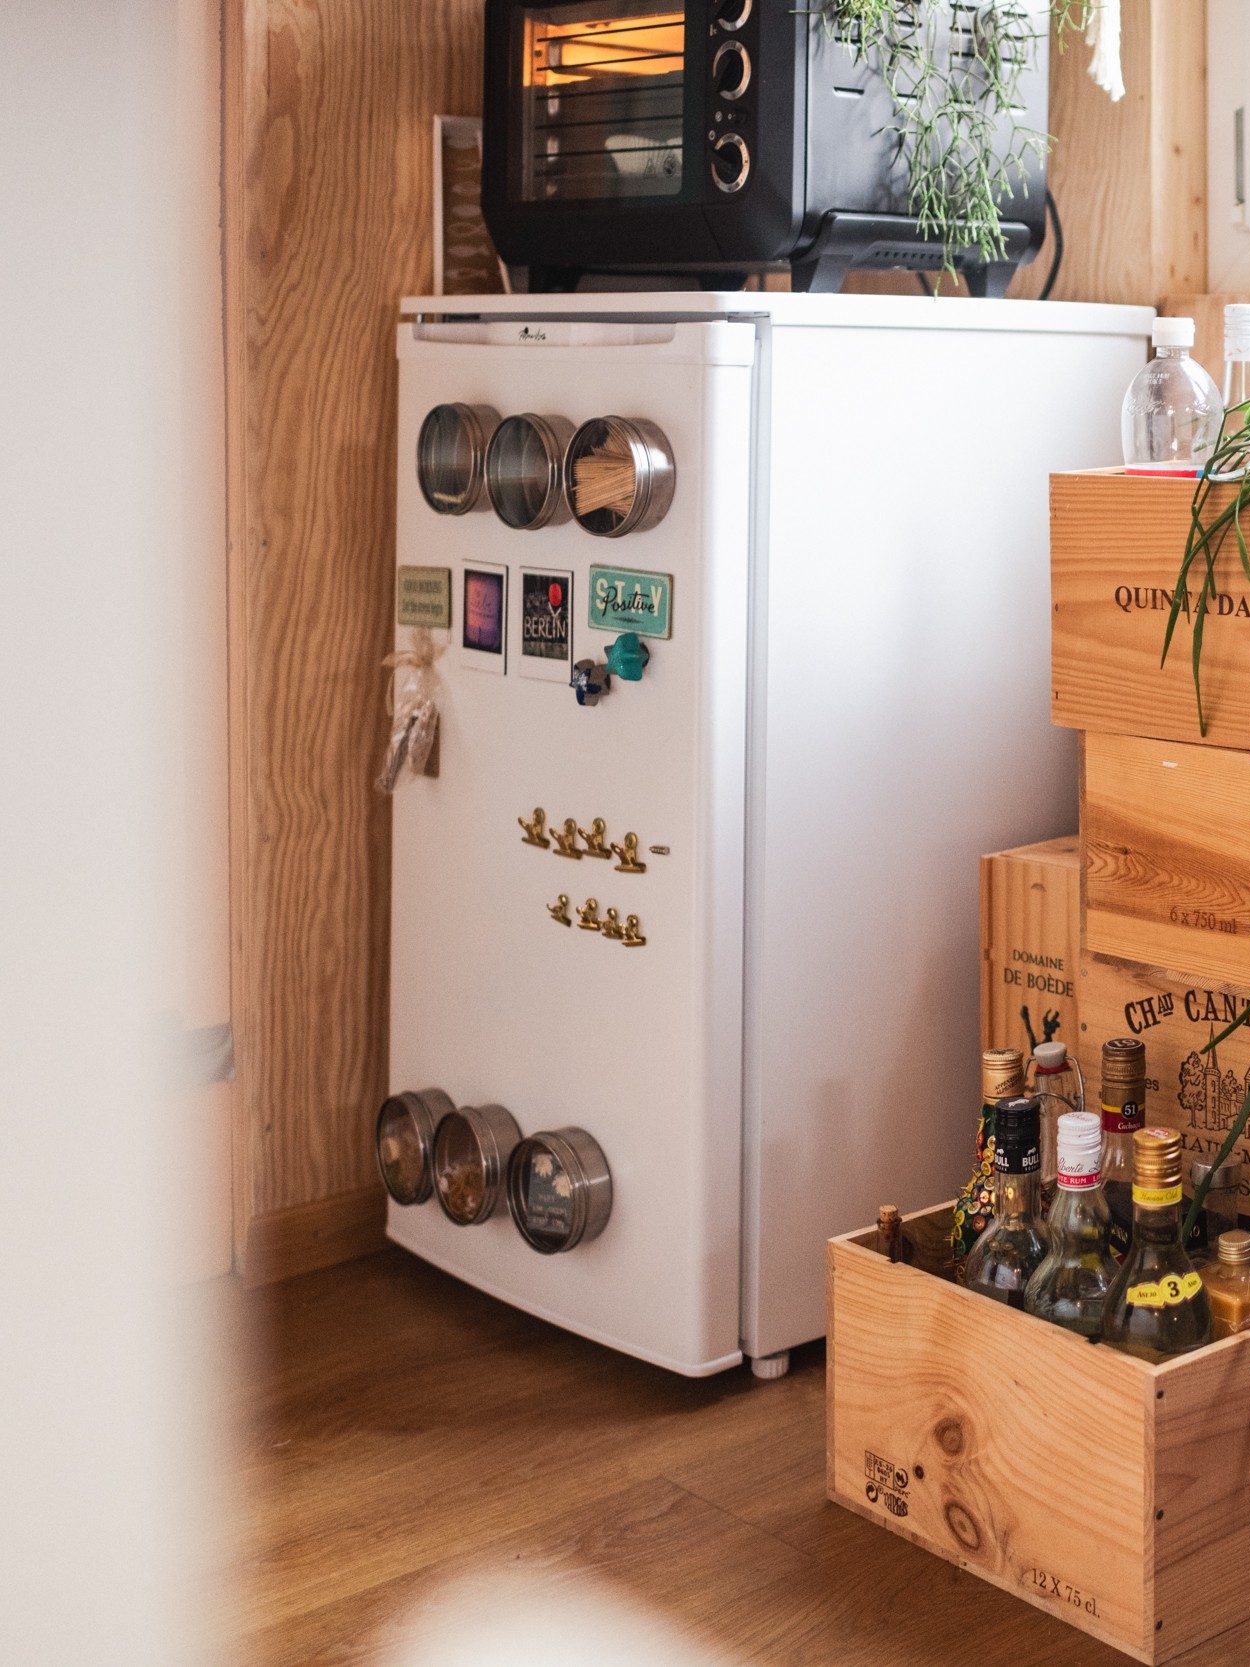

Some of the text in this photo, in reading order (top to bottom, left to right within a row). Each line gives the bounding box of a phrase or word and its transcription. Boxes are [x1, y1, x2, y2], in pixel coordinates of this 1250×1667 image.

[595, 577, 663, 617] STAY
[601, 586, 655, 617] Positive
[524, 616, 566, 639] BERLIN
[1170, 905, 1178, 922] 6
[1193, 908, 1216, 930] 750
[1219, 918, 1237, 935] ml
[1013, 949, 1064, 971] DOMAINE
[1003, 967, 1074, 998] DE BOÈDE
[1124, 1103, 1136, 1117] 51
[1022, 1153, 1040, 1168] BULL
[1069, 1177, 1087, 1185] RUM
[1167, 1280, 1181, 1298] 3
[1032, 1568, 1047, 1589] 12
[1050, 1576, 1061, 1597] X
[1065, 1585, 1081, 1607] 75
